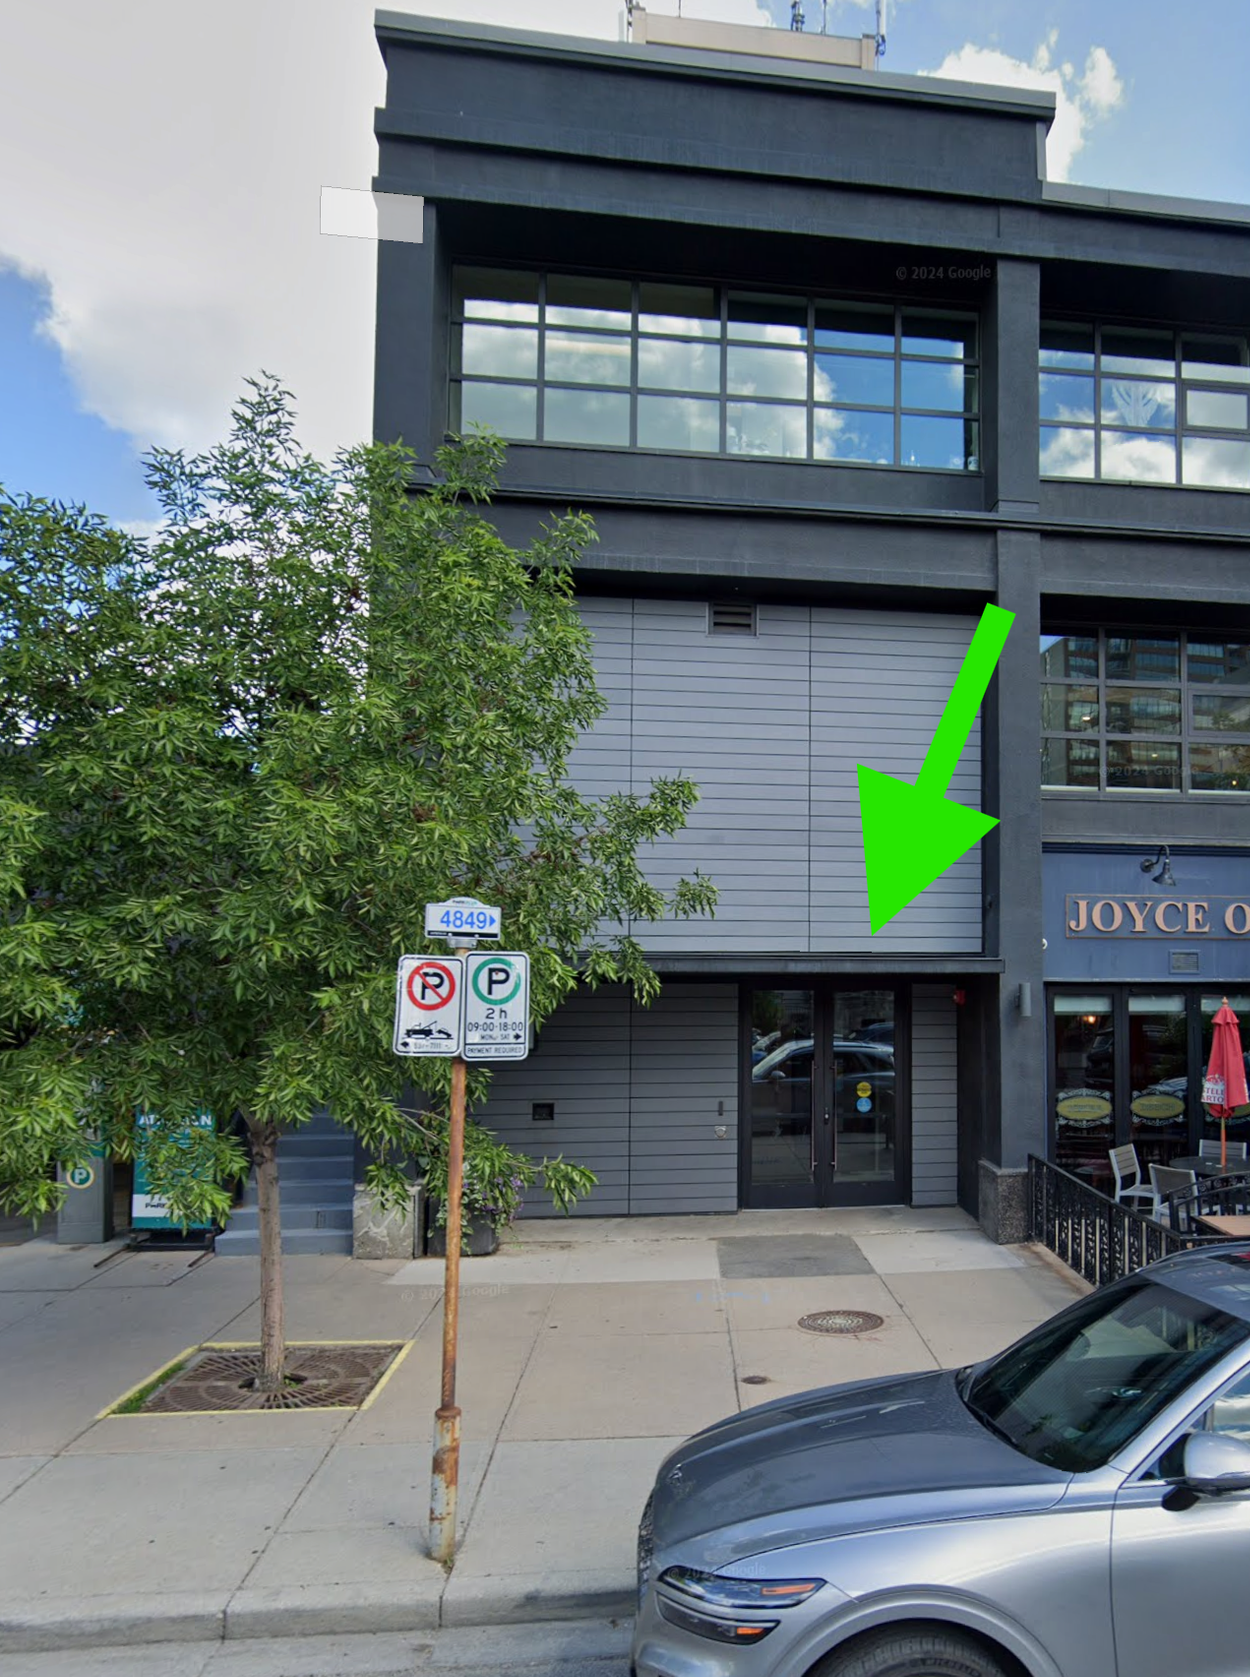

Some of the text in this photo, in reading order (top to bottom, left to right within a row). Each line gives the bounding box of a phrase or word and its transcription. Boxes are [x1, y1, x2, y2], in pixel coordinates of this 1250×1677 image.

[440, 910, 488, 930] 4849
[1069, 899, 1210, 933] JOYCE
[486, 1007, 507, 1019] 2 h
